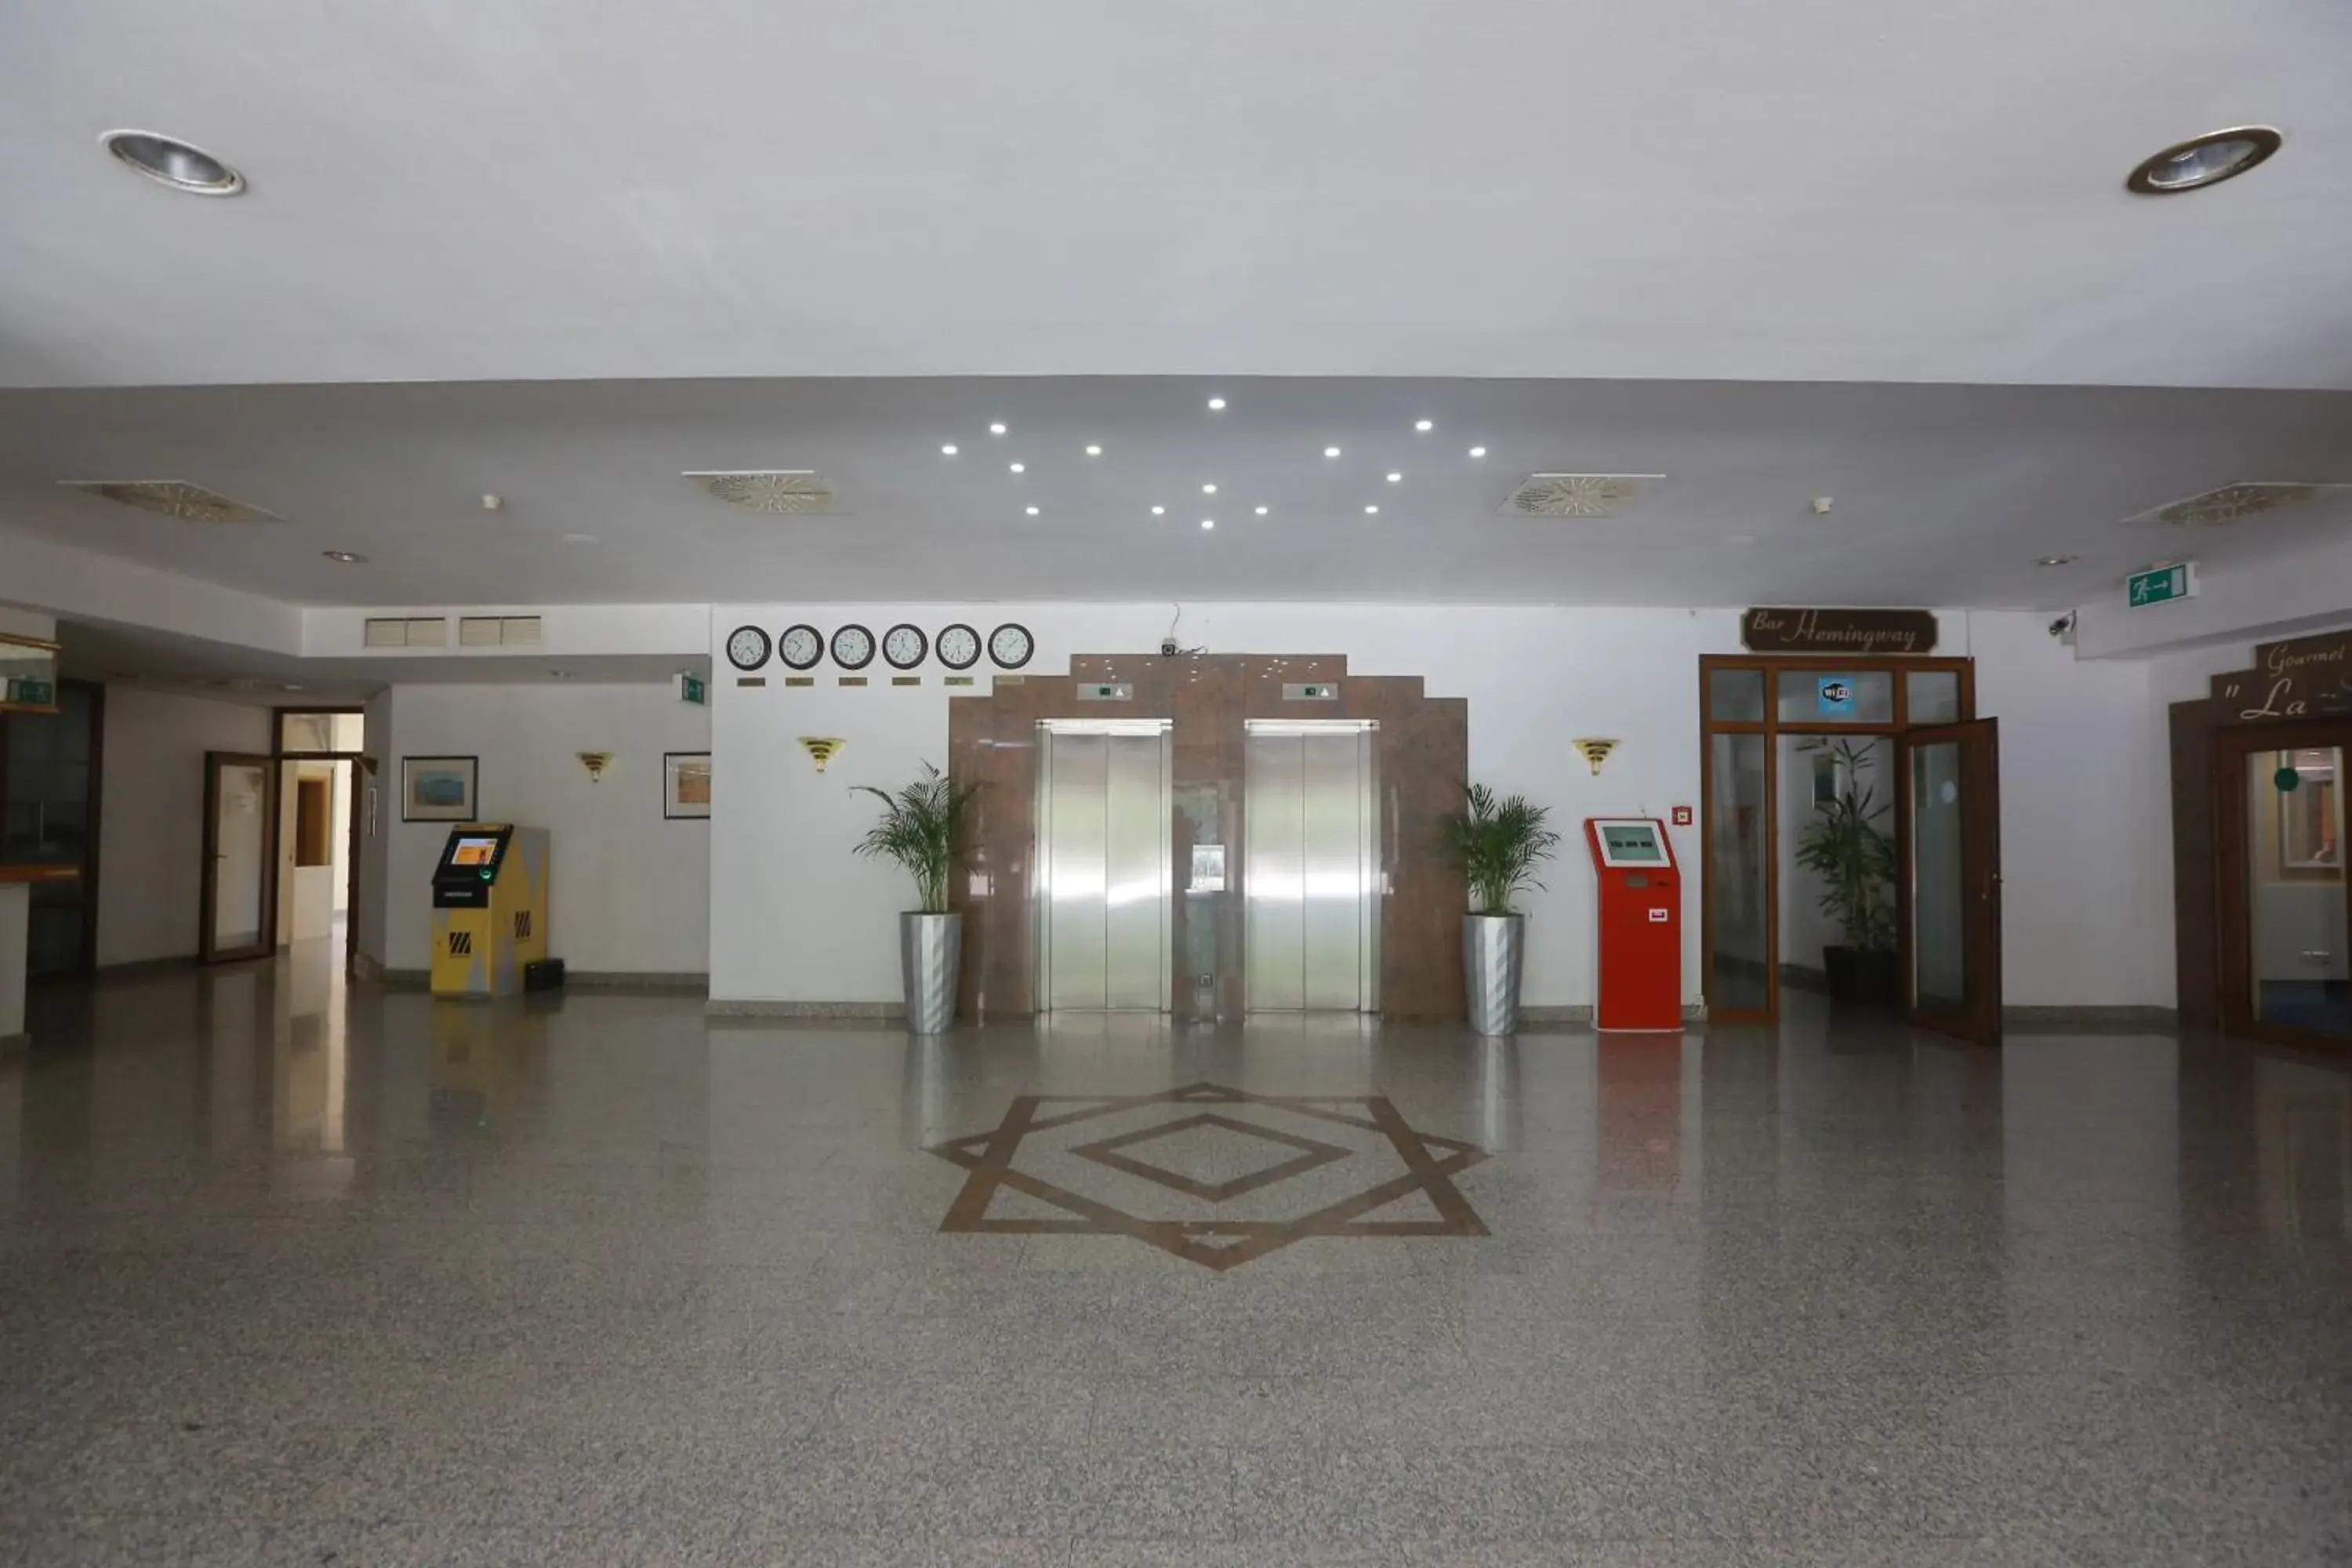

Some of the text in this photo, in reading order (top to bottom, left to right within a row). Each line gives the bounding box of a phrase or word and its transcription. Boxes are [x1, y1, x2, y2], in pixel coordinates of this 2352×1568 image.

[1752, 609, 1916, 652] Bar Hemingway
[2268, 642, 2345, 677] Gourmet
